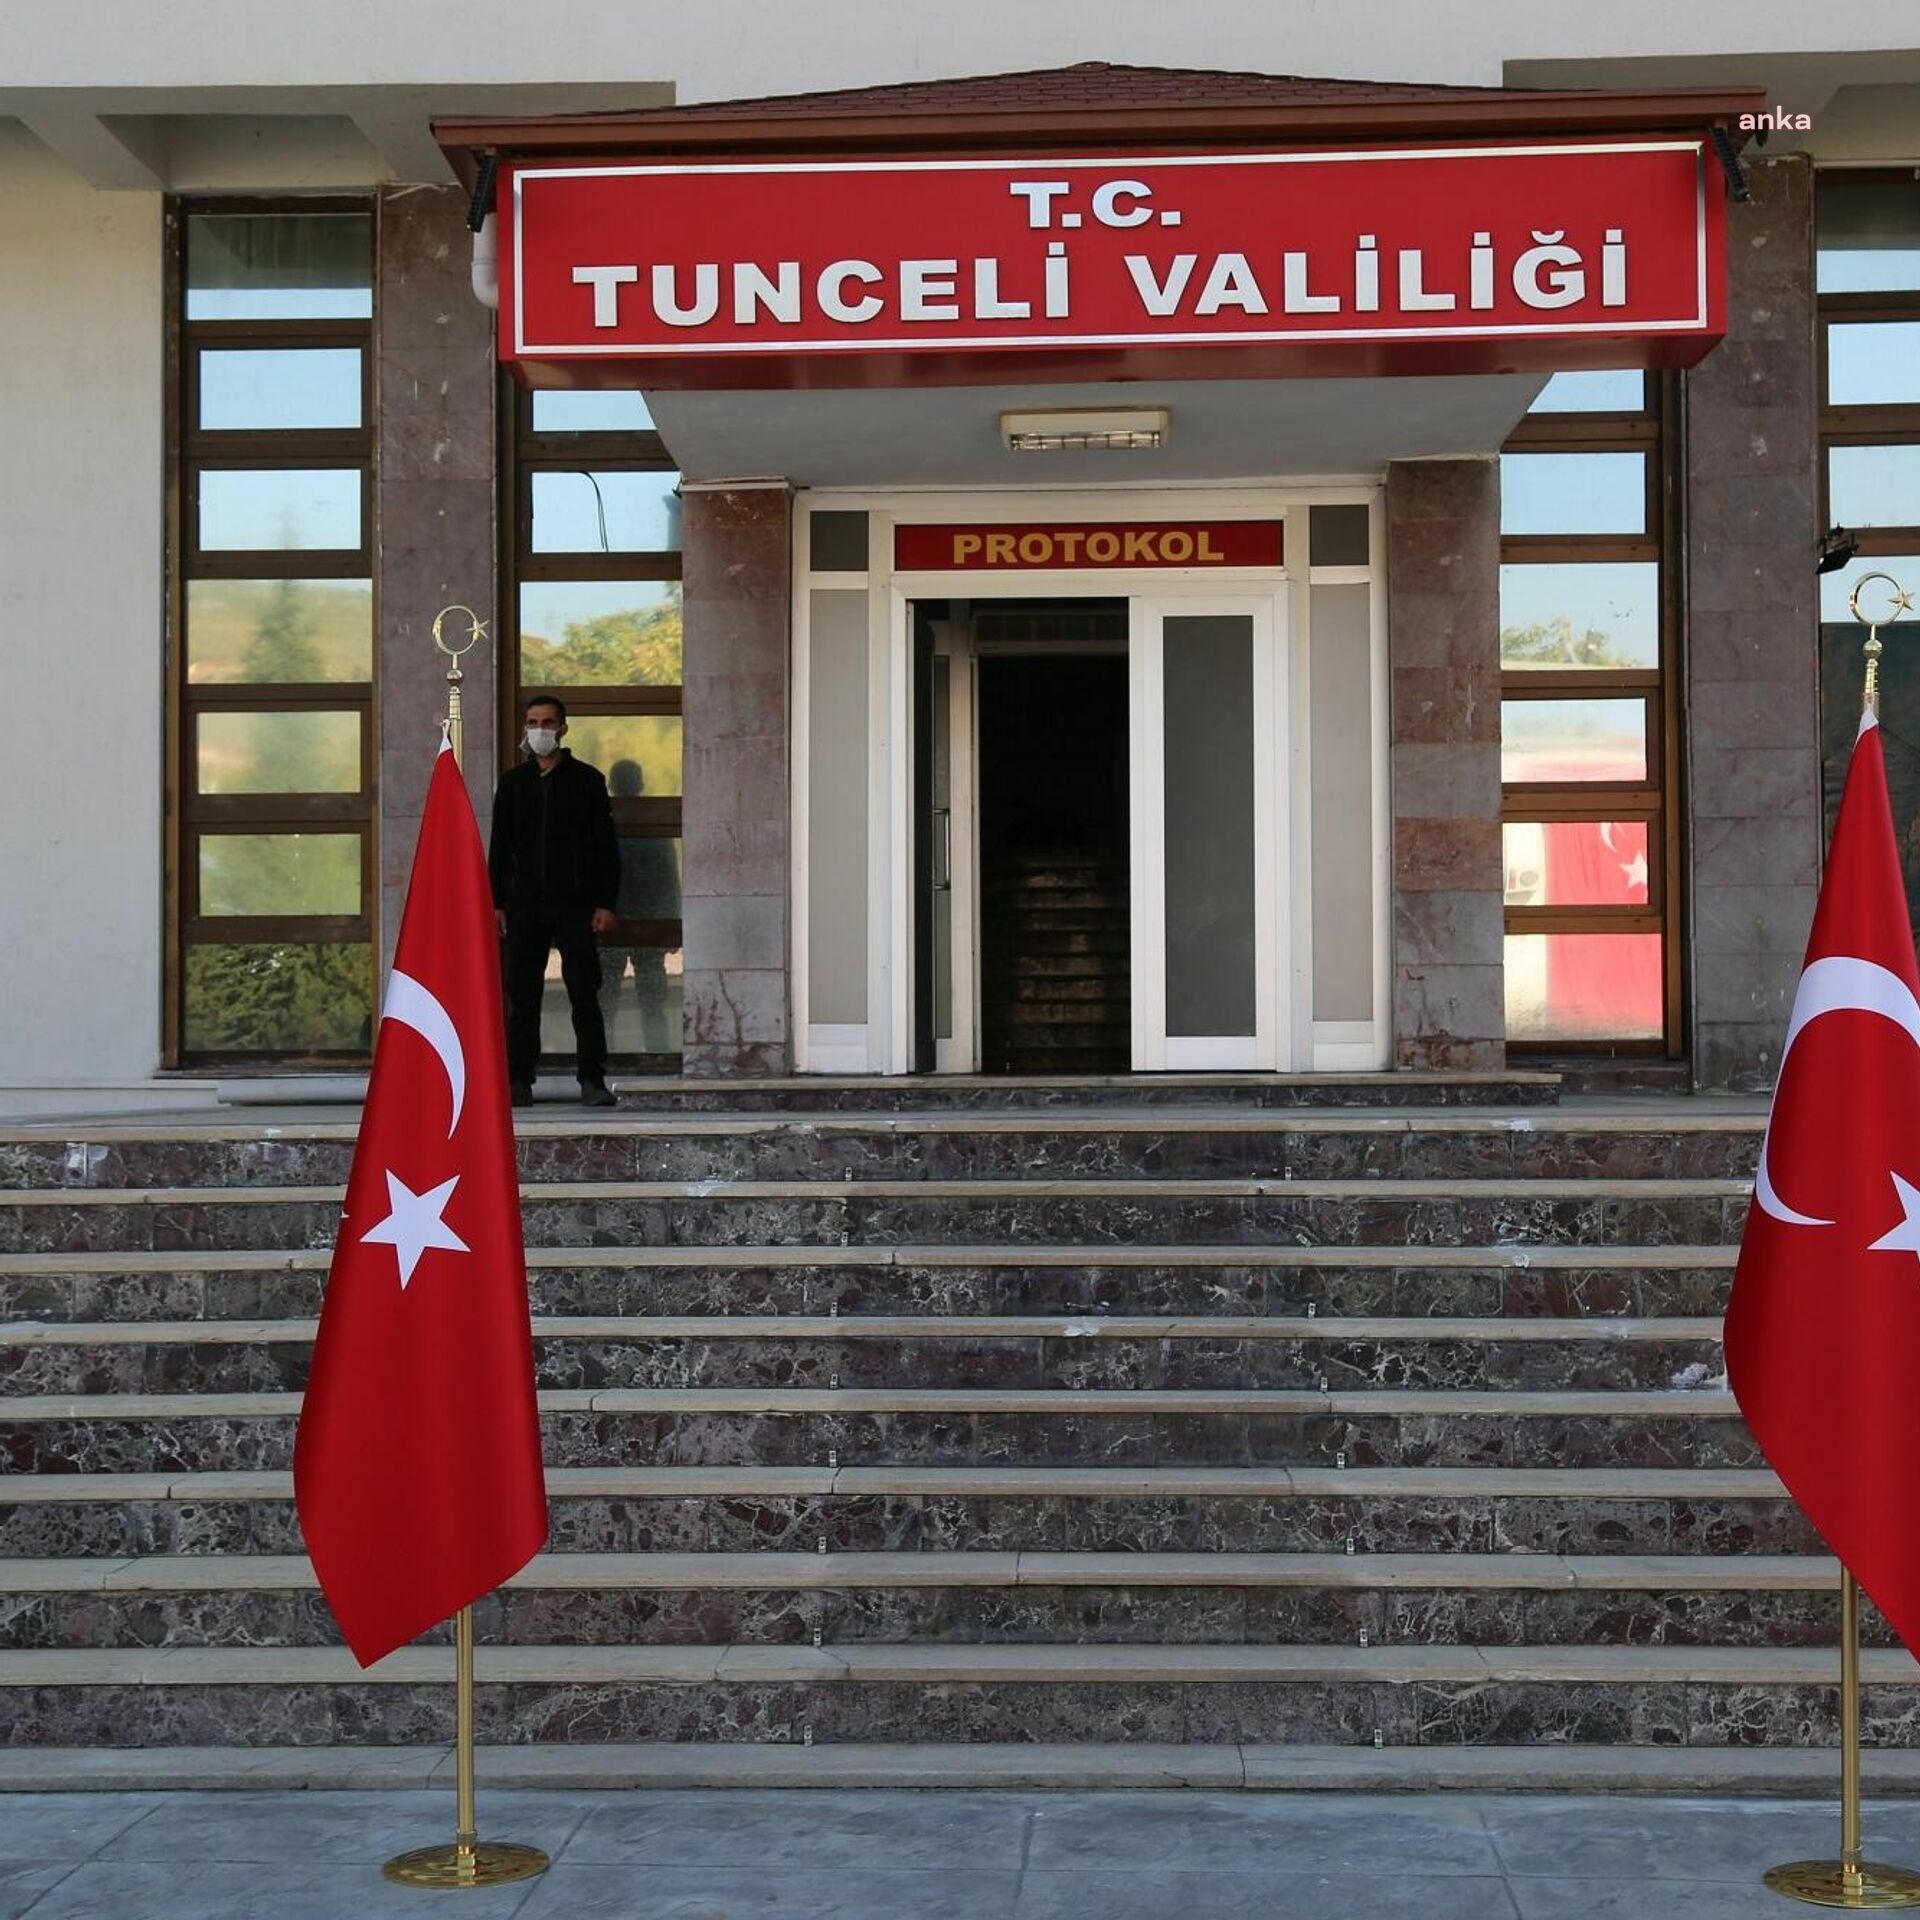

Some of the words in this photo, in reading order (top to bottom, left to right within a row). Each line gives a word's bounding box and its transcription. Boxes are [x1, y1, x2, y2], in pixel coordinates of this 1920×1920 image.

[1010, 180, 1180, 229] T.C.
[572, 241, 1070, 328] TUNCELİ
[1124, 229, 1627, 316] VALİLİĞİ
[953, 531, 1225, 564] PROTOKOL
